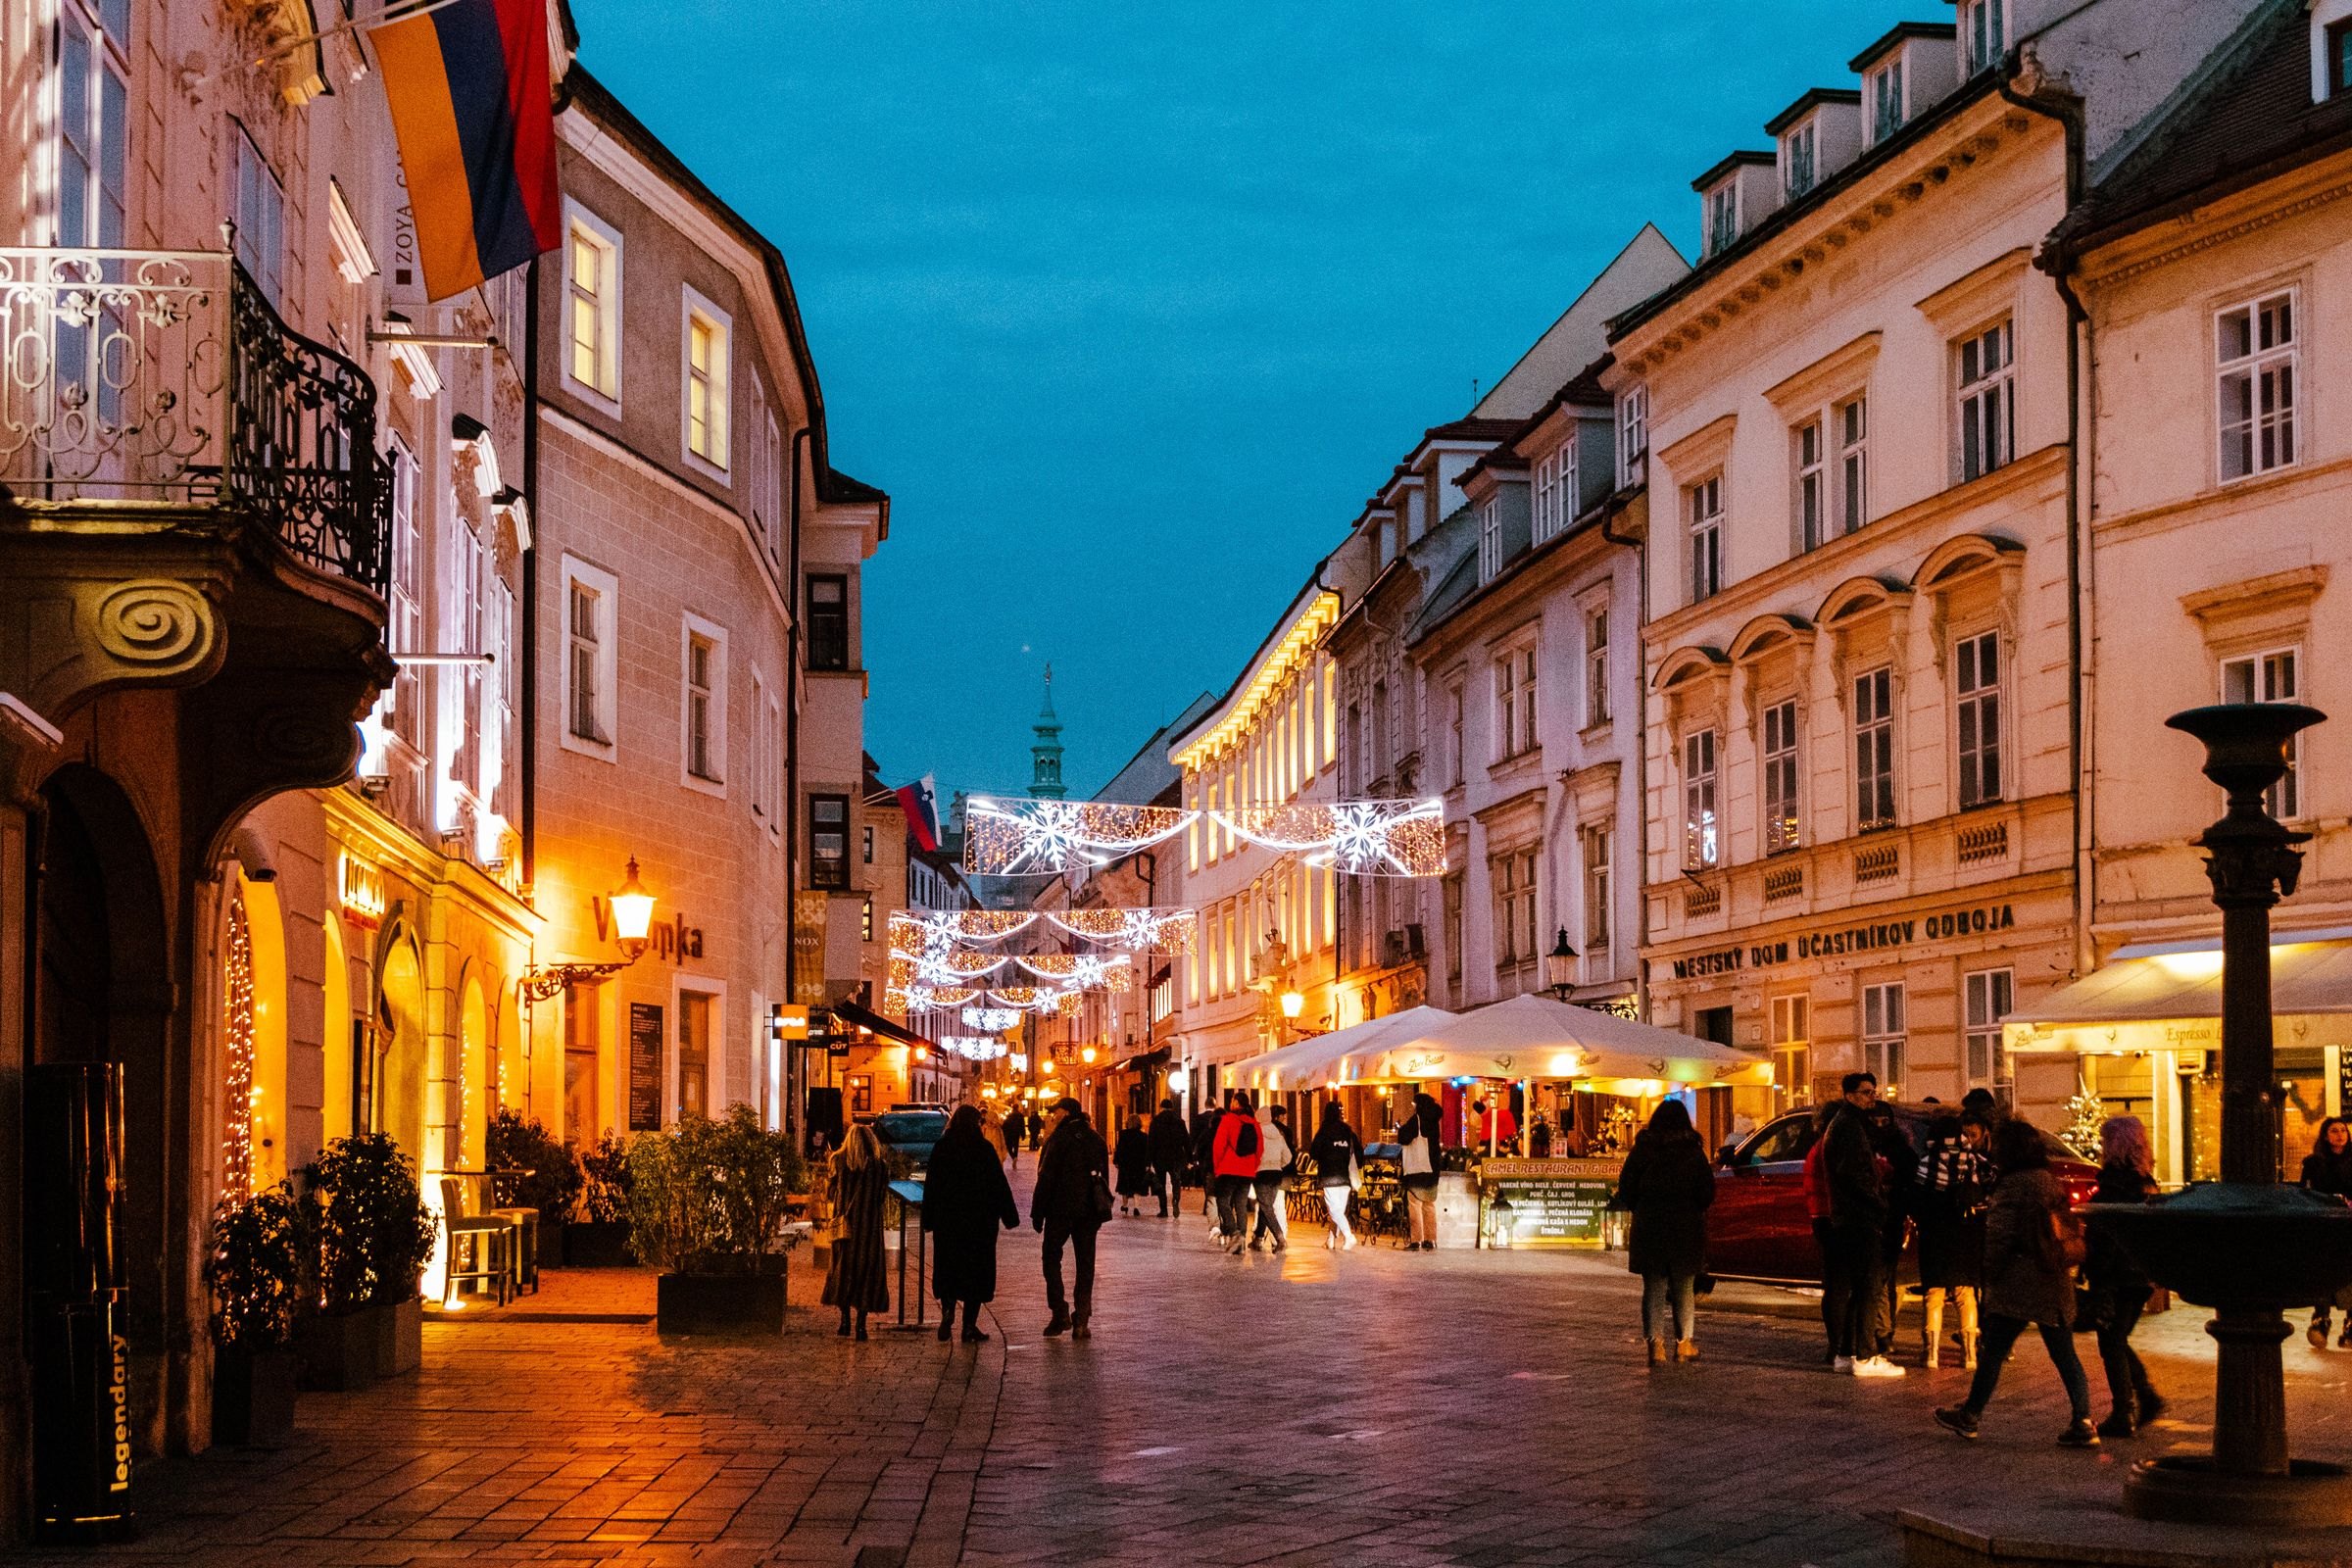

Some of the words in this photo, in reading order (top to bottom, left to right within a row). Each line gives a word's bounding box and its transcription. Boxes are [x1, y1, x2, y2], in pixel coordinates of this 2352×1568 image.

[396, 205, 413, 263] ZOYA
[1751, 942, 1788, 967] DOM
[1926, 905, 2014, 939] ODBOJA
[2167, 1027, 2210, 1045] Espresso
[1485, 1162, 1518, 1175] CAMEL
[1519, 1162, 1589, 1175] RESTAURANT
[1591, 1163, 1599, 1174] &
[1600, 1162, 1623, 1175] BAR
[110, 1334, 129, 1493] legendary
